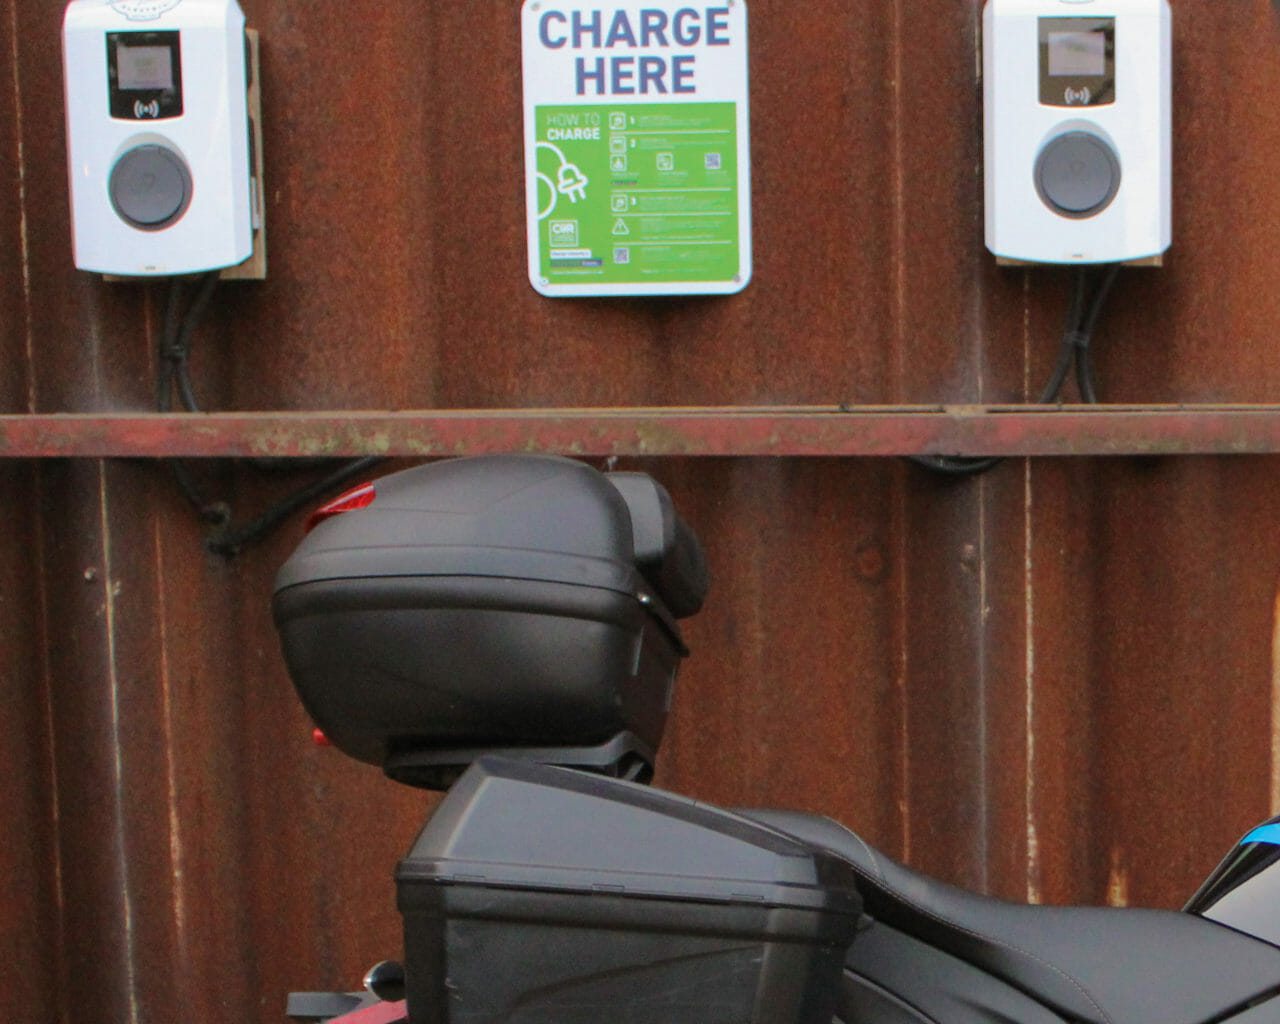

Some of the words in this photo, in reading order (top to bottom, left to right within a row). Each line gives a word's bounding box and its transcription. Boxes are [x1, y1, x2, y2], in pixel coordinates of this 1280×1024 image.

[538, 7, 730, 49] CHARGE
[575, 55, 696, 95] HERE
[547, 112, 578, 126] HOW
[584, 112, 600, 126] TO
[547, 128, 600, 140] CHARGE
